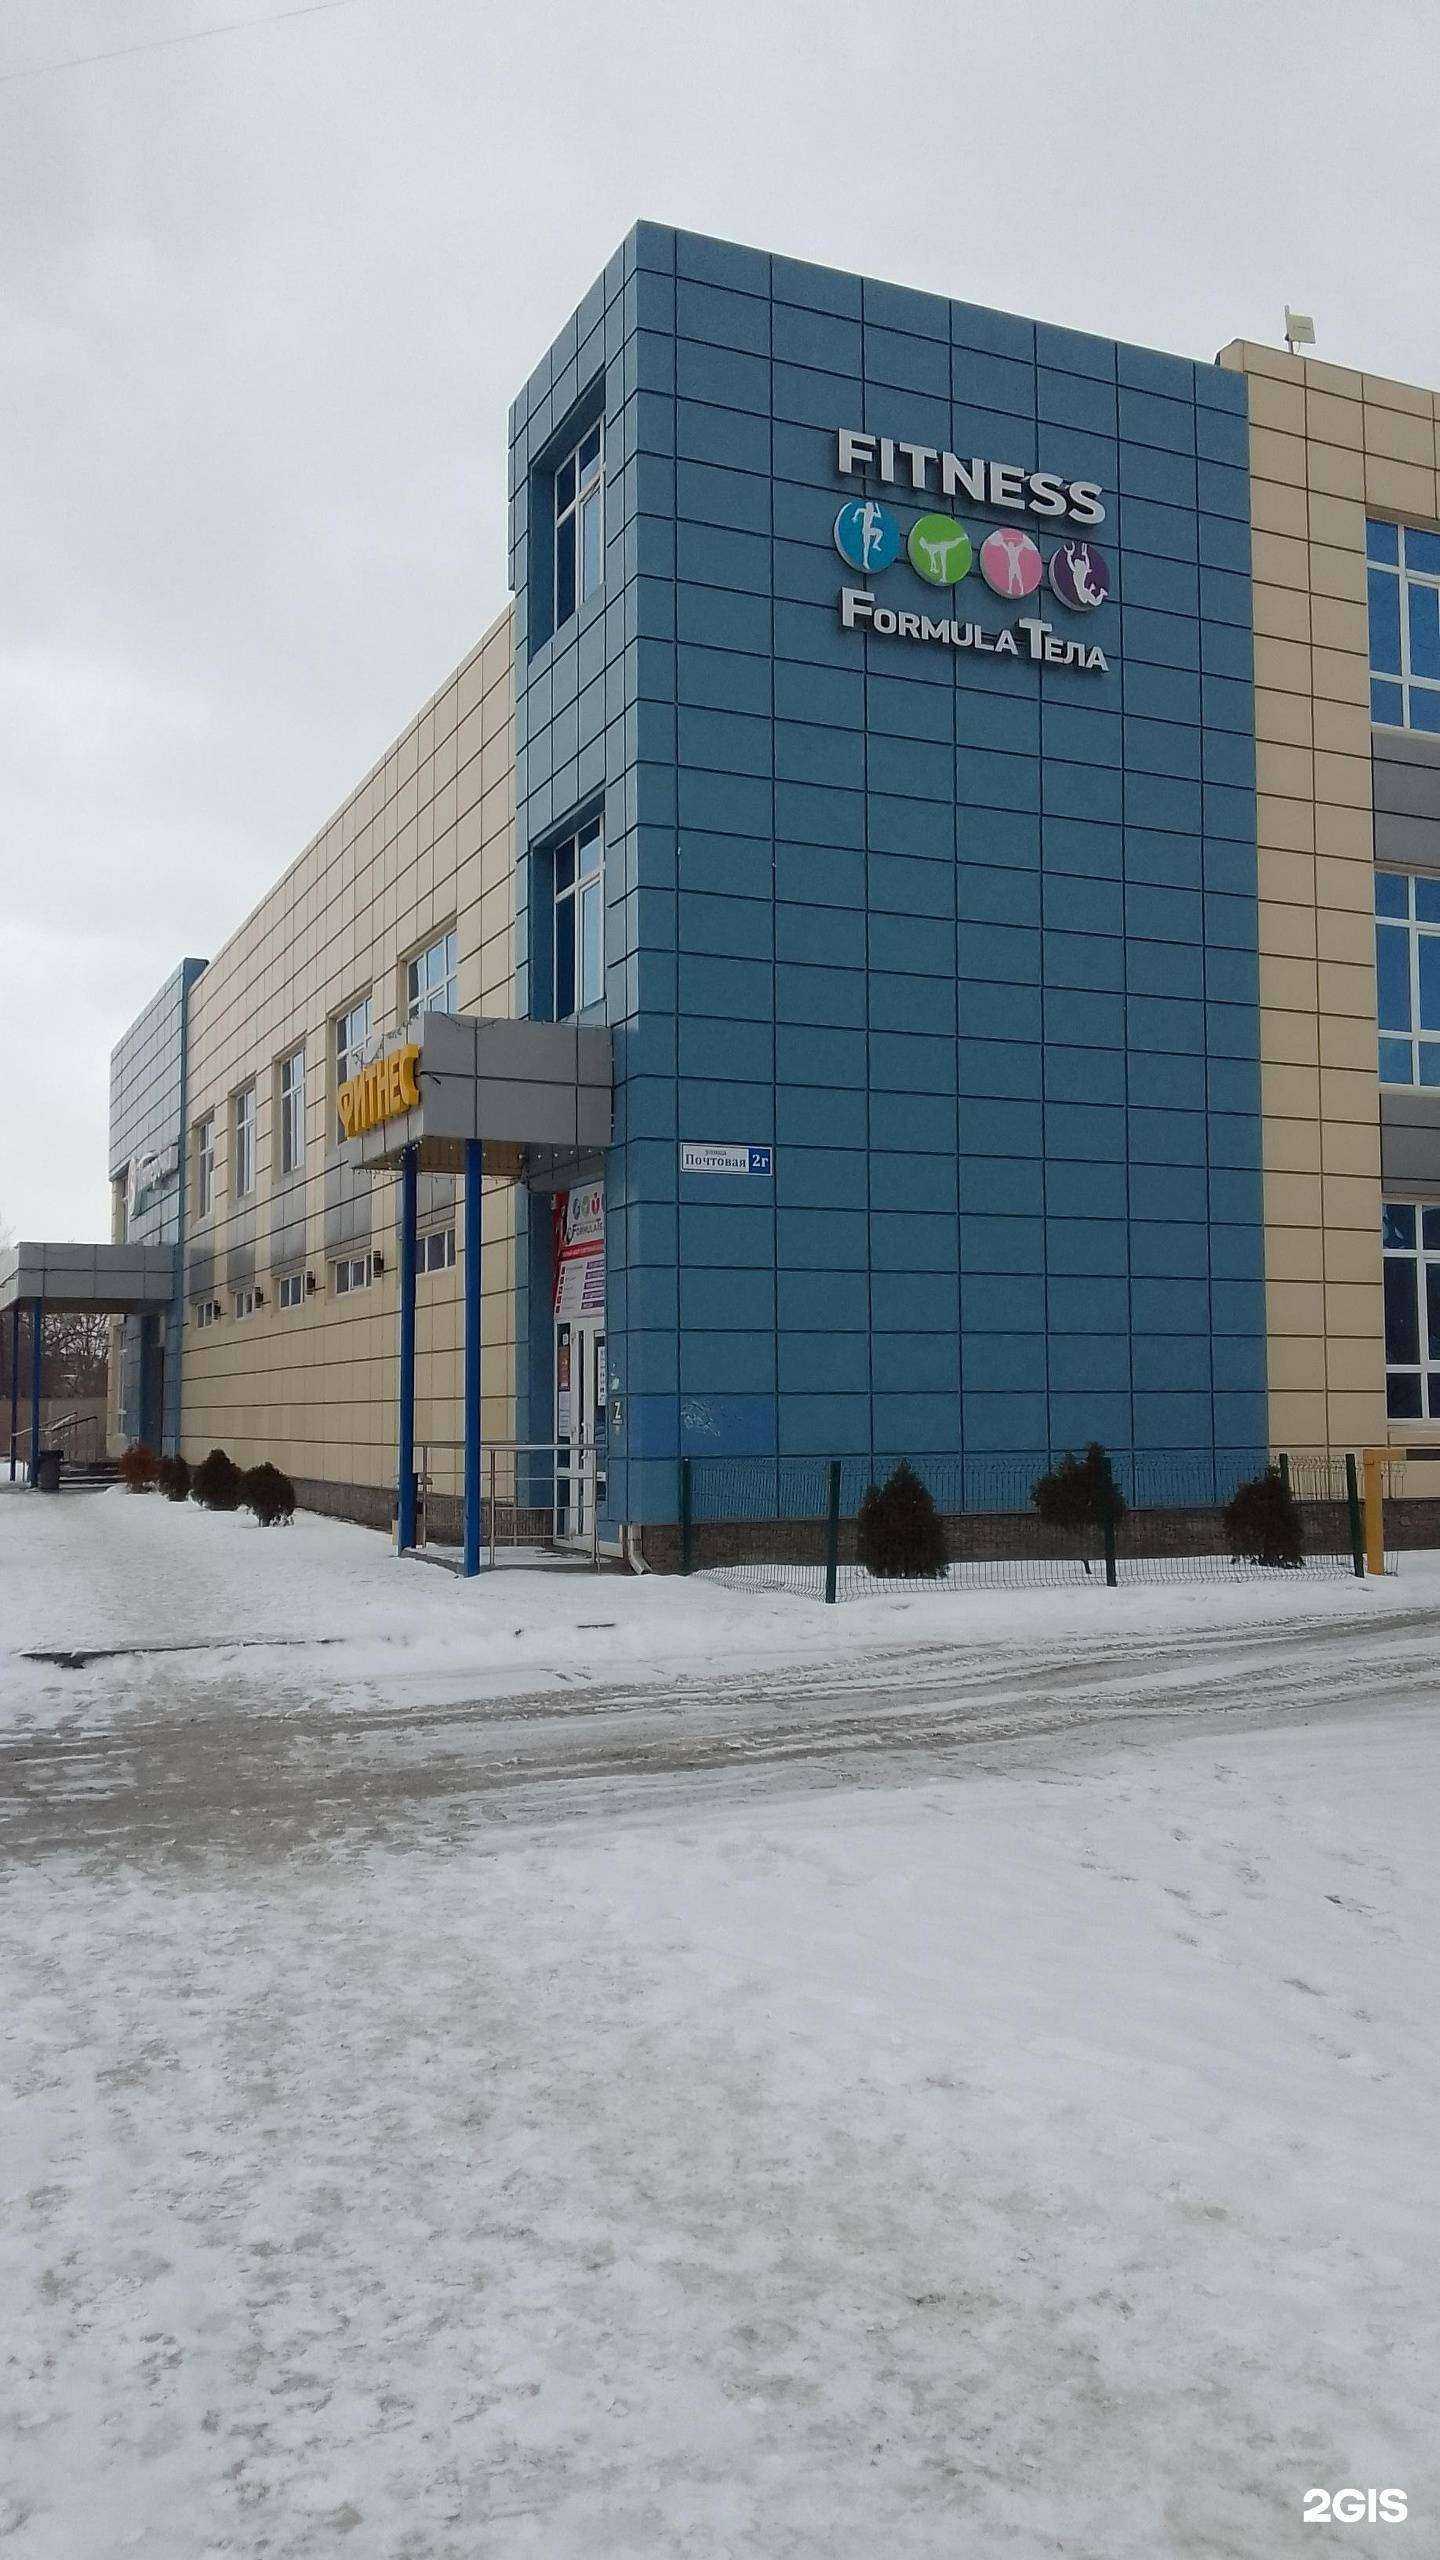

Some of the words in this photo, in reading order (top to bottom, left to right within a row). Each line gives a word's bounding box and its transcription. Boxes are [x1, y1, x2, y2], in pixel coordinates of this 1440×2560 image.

[839, 427, 1105, 524] FITNESS
[338, 1043, 420, 1138] ФИТНЕС
[685, 1154, 746, 1168] Почтовая
[752, 1154, 769, 1167] 2г
